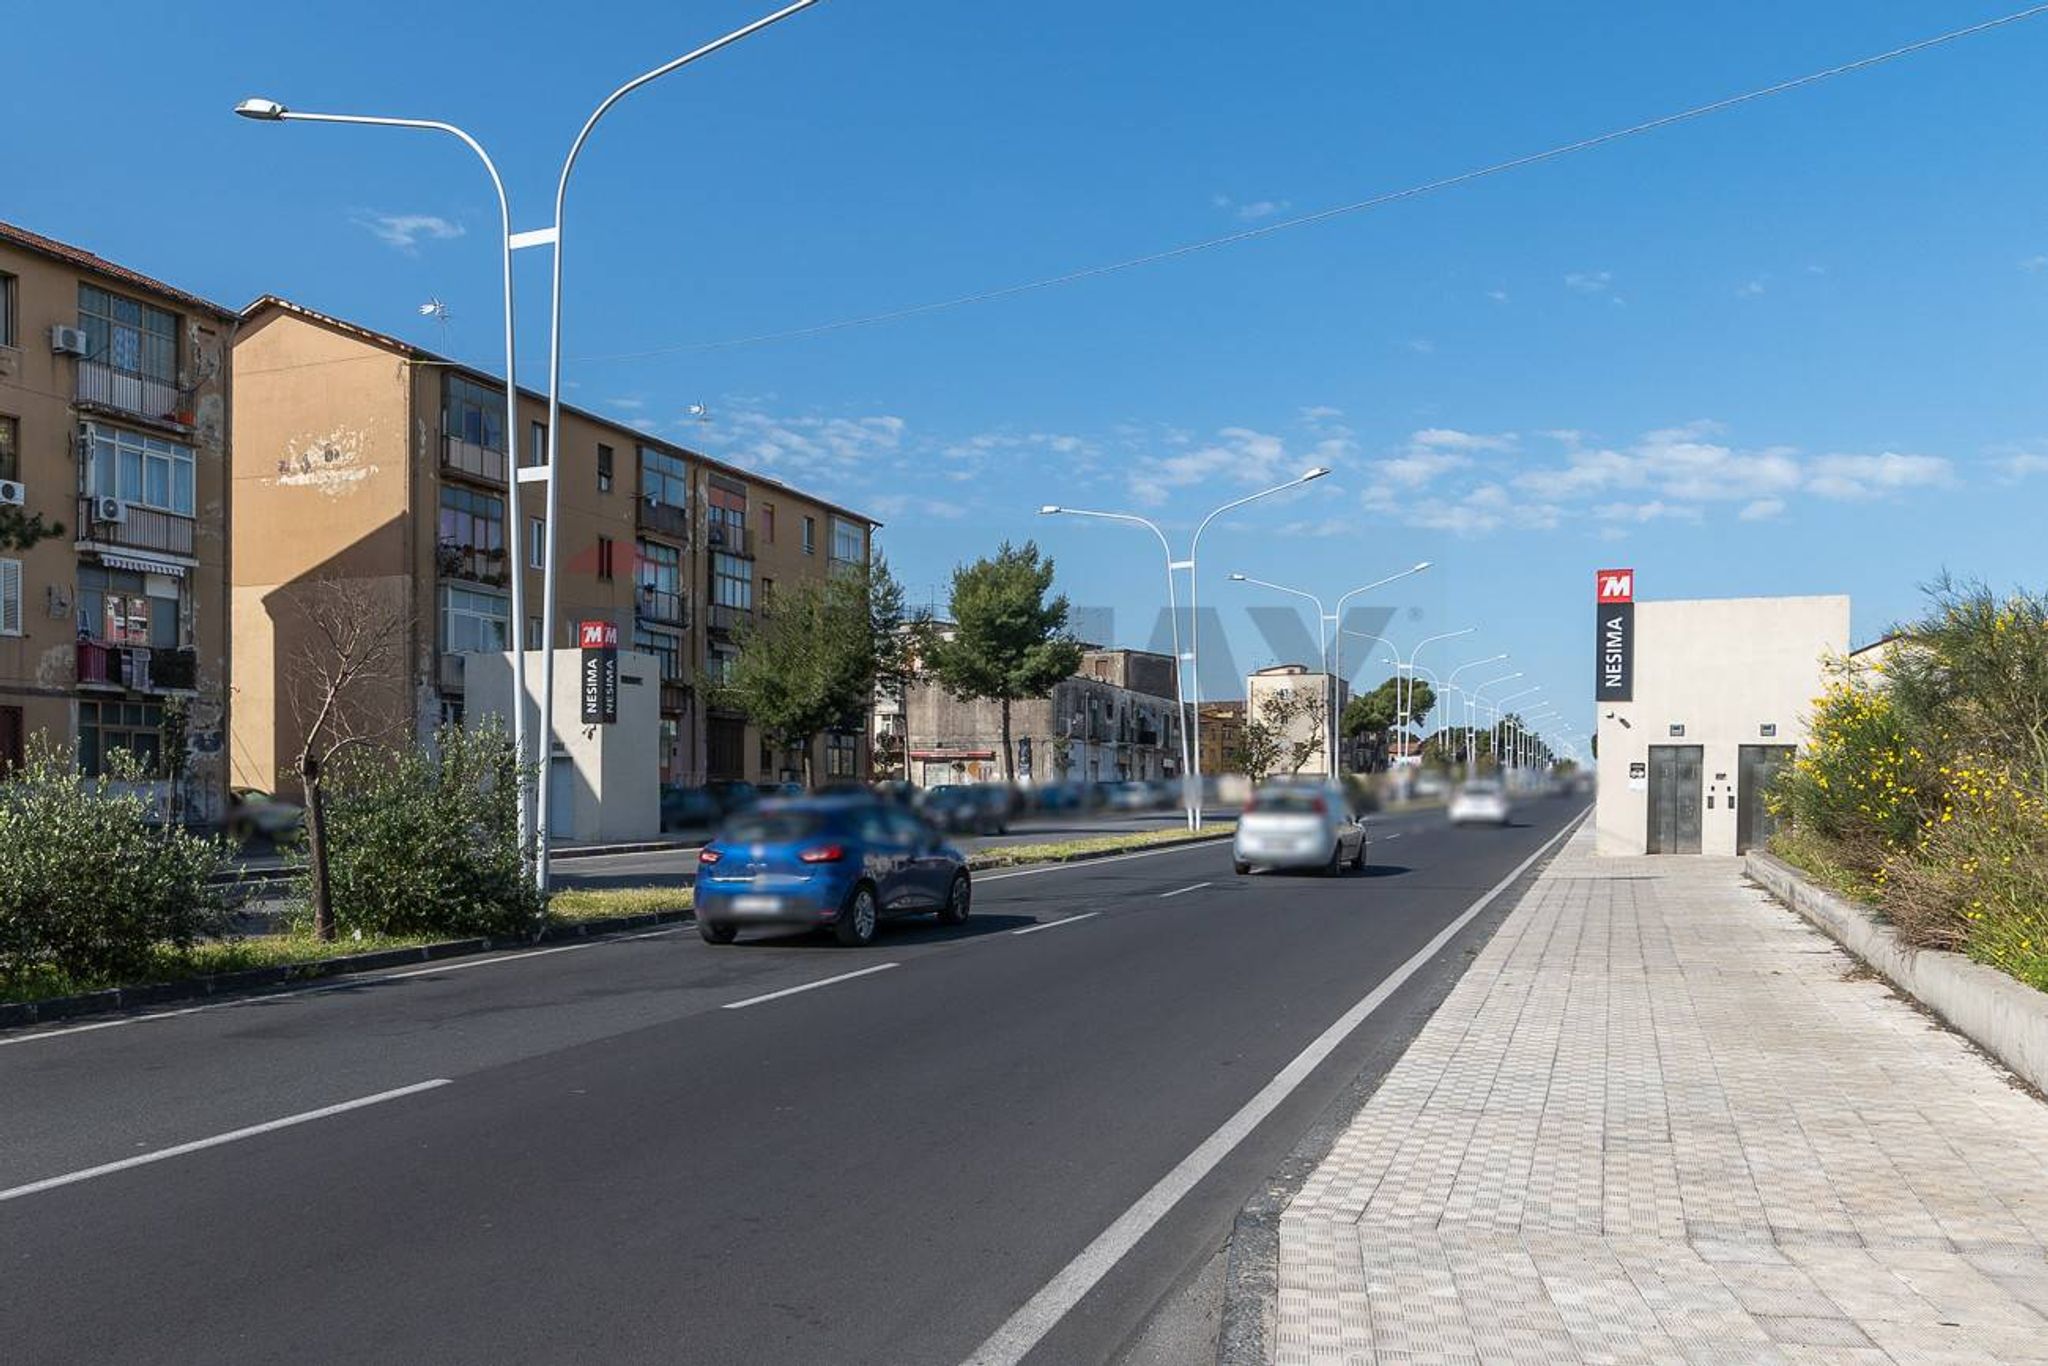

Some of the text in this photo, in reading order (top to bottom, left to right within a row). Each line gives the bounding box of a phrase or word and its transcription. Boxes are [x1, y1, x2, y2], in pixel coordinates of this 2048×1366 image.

[1605, 617, 1623, 687] NESIMA
[586, 658, 598, 714] NESIMA
[606, 660, 614, 714] NESIMA
